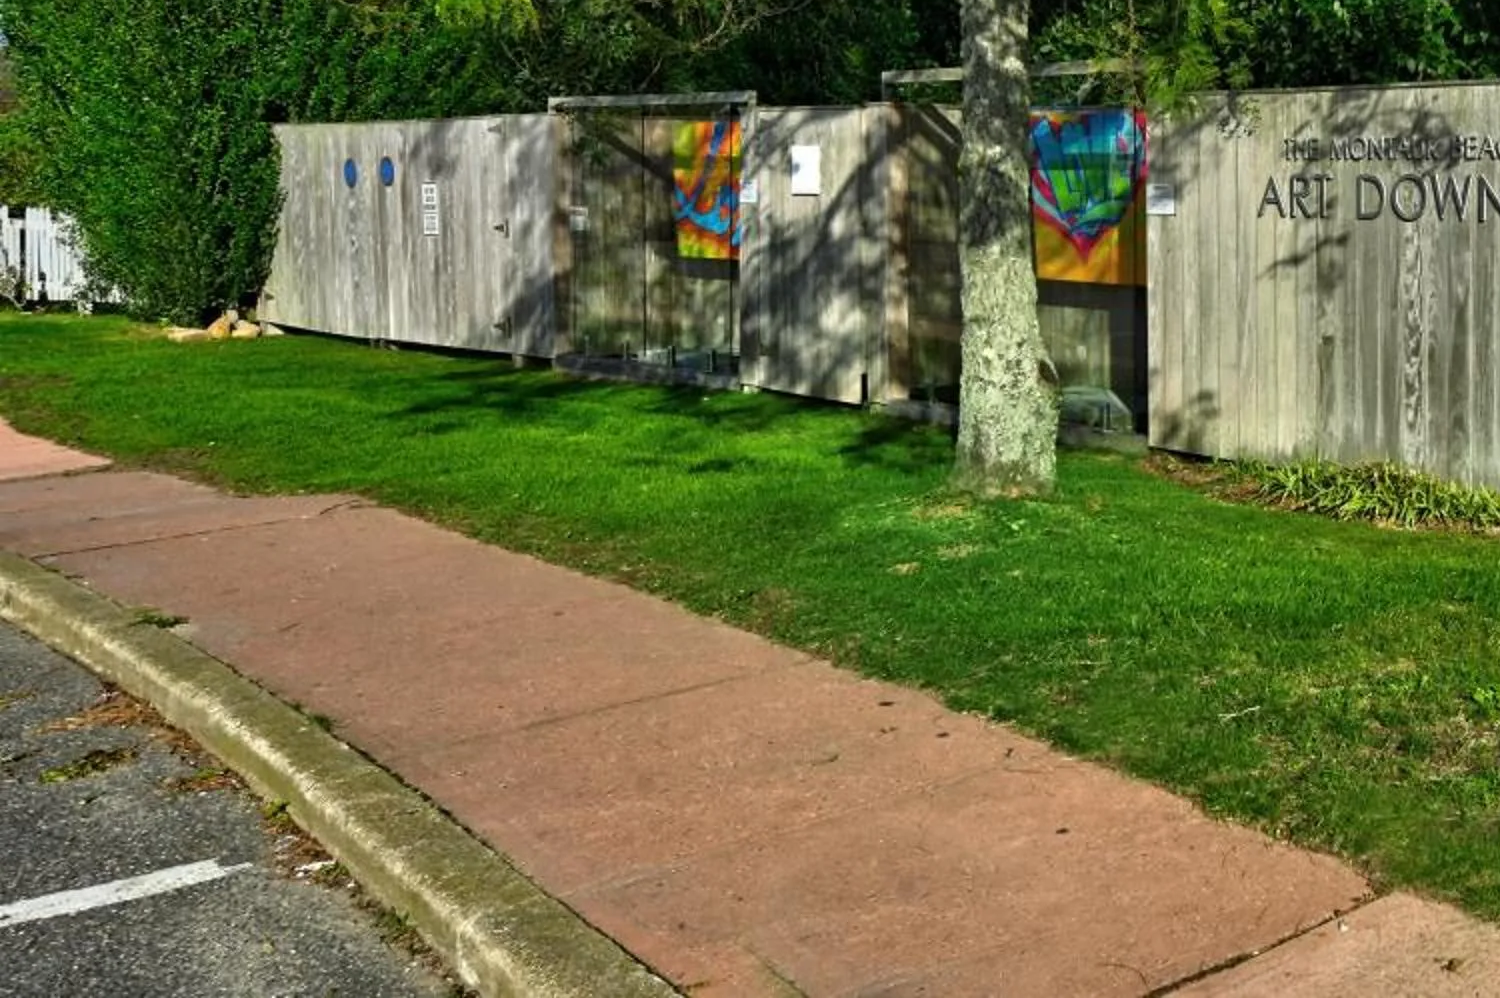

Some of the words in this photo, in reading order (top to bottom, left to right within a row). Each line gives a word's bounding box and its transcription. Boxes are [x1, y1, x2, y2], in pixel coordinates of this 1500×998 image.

[1283, 136, 1320, 162] THE
[1329, 135, 1442, 162] MONTAUK
[1257, 174, 1334, 220] ART
